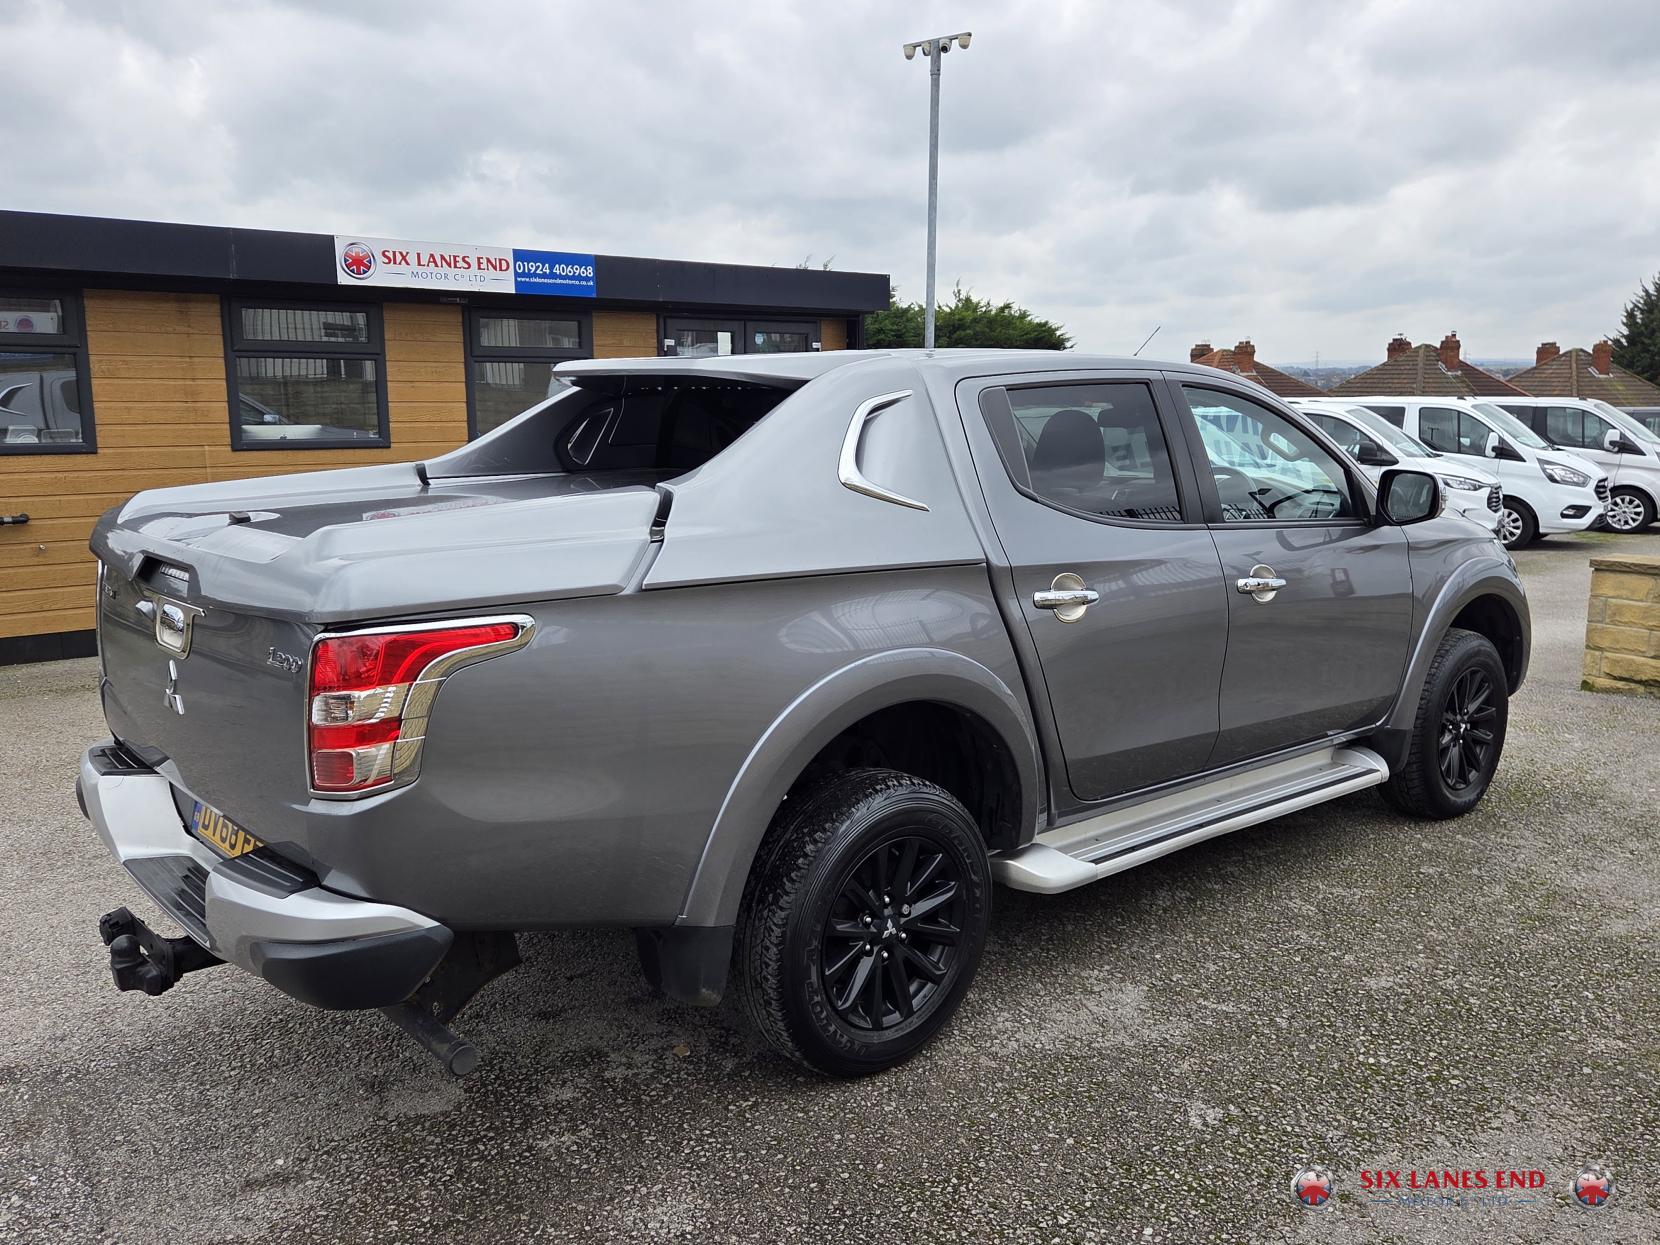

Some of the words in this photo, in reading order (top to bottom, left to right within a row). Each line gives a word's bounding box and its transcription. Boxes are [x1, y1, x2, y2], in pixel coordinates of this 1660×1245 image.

[381, 249, 410, 266] SIX
[416, 252, 472, 270] LANES
[476, 256, 510, 272] END
[411, 271, 450, 281] MOTOR
[468, 274, 486, 283] LTD
[516, 261, 550, 275] 01924
[553, 264, 594, 277] 406968
